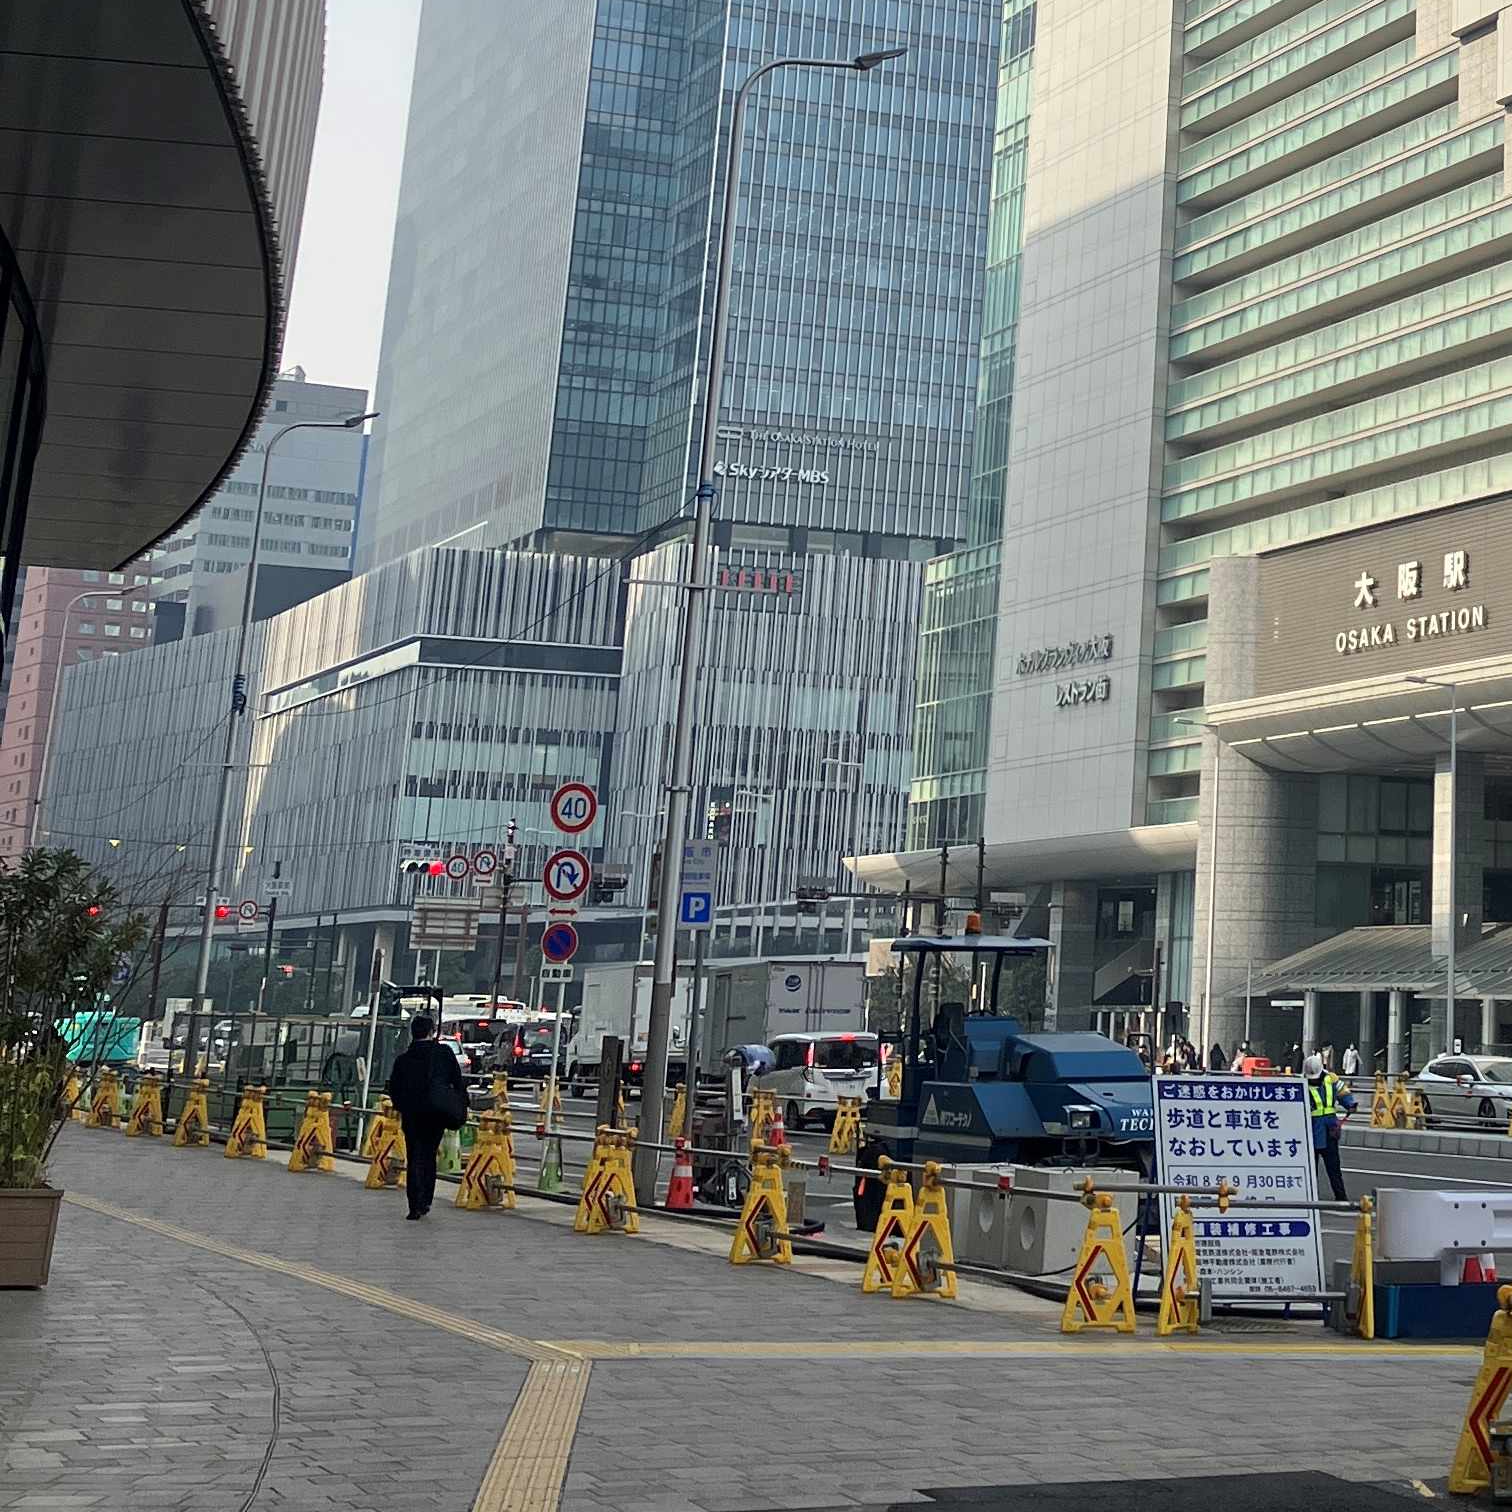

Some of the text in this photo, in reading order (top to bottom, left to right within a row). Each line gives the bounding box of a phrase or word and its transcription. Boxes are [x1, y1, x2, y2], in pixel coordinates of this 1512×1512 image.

[1354, 550, 1467, 607] 大阪駅
[1335, 605, 1484, 653] OSAKA STATION
[561, 797, 587, 819] 40
[453, 861, 464, 873] 40
[689, 896, 705, 919] P
[1163, 1084, 1299, 1099] ご迷惑をおかけします
[1132, 1109, 1154, 1118] WA
[1167, 1108, 1280, 1130] 歩道と車道を
[1169, 1138, 1301, 1158] なおしています
